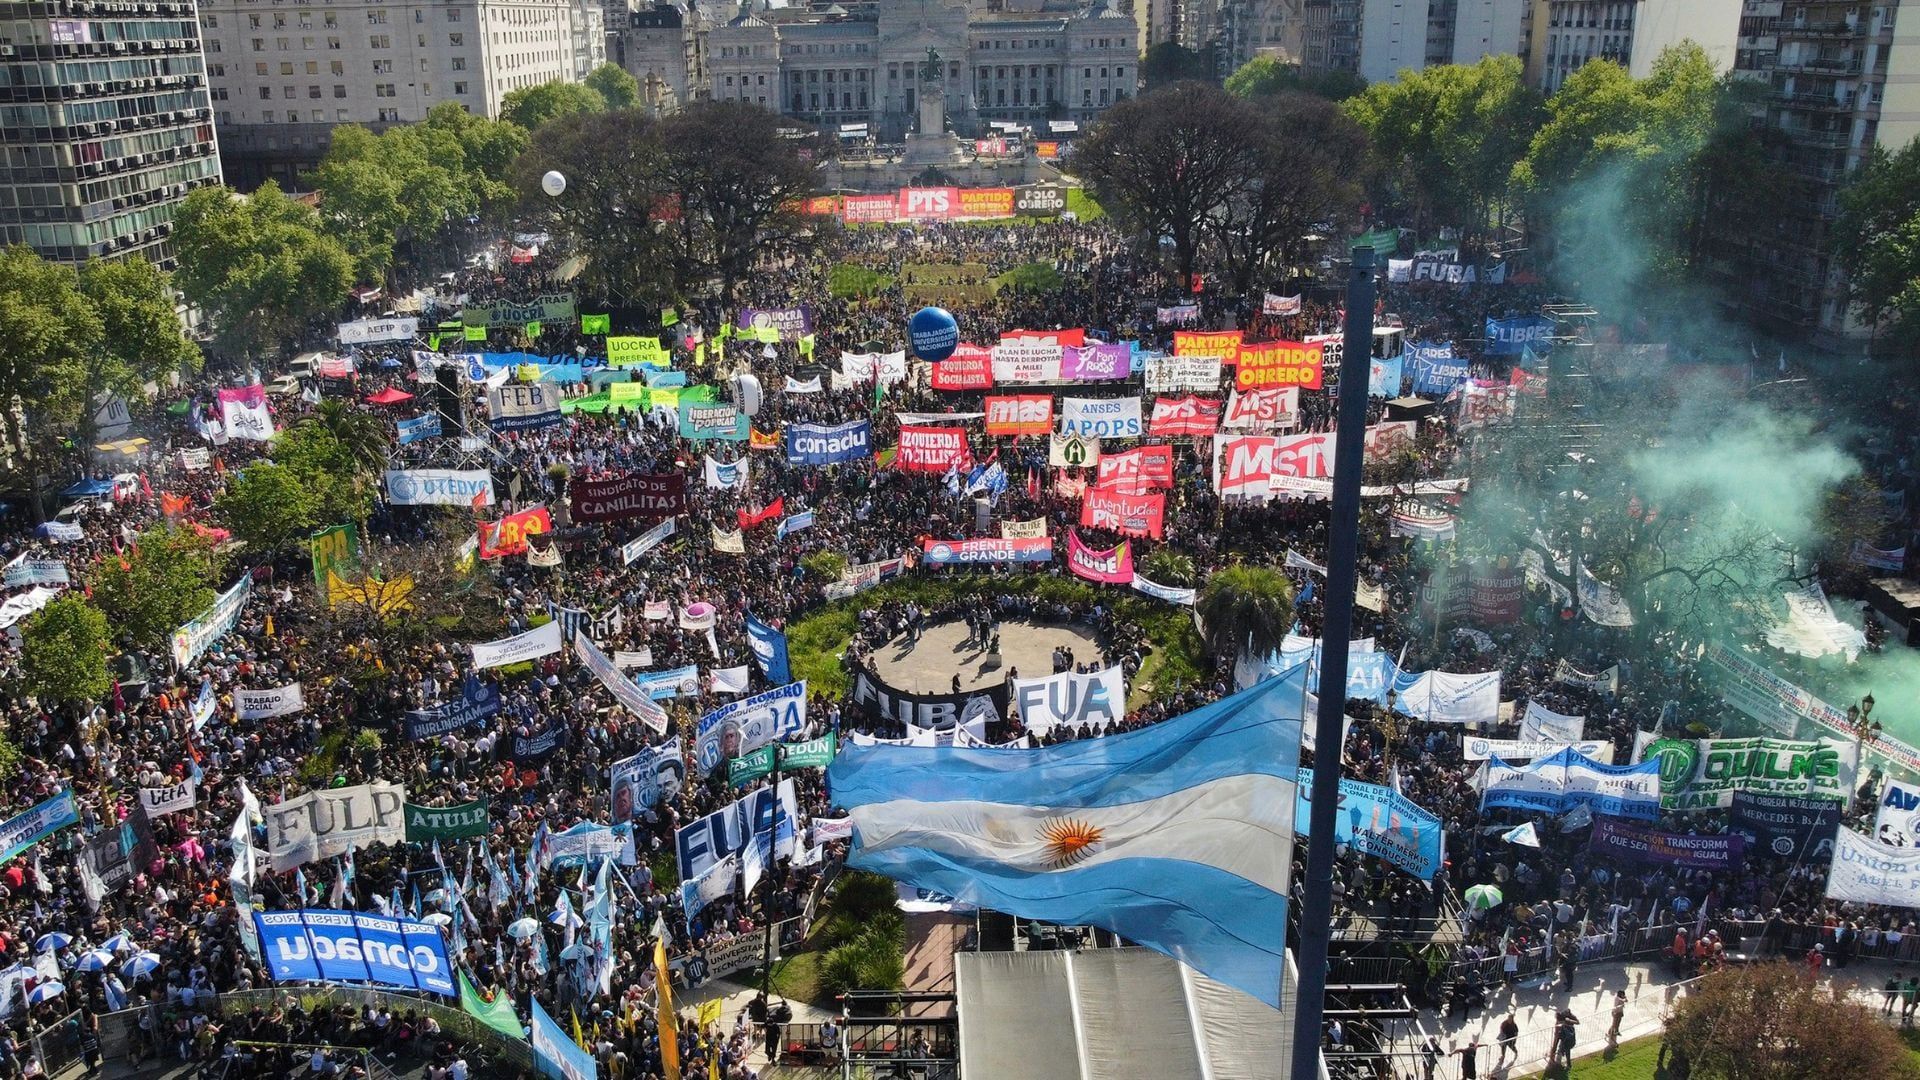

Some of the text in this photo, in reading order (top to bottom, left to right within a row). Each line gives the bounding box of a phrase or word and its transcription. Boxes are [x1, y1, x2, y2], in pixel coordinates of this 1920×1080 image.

[908, 190, 949, 212] PTS
[962, 191, 1011, 202] PARTIDO
[1025, 190, 1056, 200] POLO
[847, 200, 892, 210] IZQUIERDA
[1018, 199, 1063, 210] OBRERO
[1415, 262, 1475, 283] FUBA
[503, 306, 546, 321] UOCRA
[772, 310, 803, 321] UOCRA
[367, 324, 395, 334] AEFIP
[912, 326, 955, 339] TRABAJADORES
[1500, 326, 1554, 343] LIBRES
[612, 340, 656, 351] UOCRA
[918, 341, 955, 351] NACIONALES
[1177, 336, 1239, 348] PARTIDO
[614, 355, 657, 363] PRESENTE
[1240, 349, 1320, 367] PARTIDO
[938, 373, 985, 384] SOCIALISTA
[1015, 371, 1029, 379] PTS
[1239, 368, 1314, 385] OBRERO
[500, 386, 543, 407] FEB
[1241, 390, 1287, 420] MST
[997, 399, 1049, 423] mas
[1081, 403, 1121, 414] ANSES
[1152, 398, 1196, 420] PTS
[1064, 418, 1139, 436] APOPS
[795, 430, 866, 453] conadu
[901, 431, 960, 448] IZQUIERDA
[1100, 454, 1140, 477] PTS
[1228, 444, 1333, 480] MST
[424, 478, 489, 495] UTEDYC
[587, 478, 667, 497] SINDICATO DE
[581, 494, 677, 516] CANILLITAS
[1086, 493, 1146, 516] Juventud
[1093, 510, 1119, 530] PTS
[962, 541, 1013, 551] FRENTE
[960, 551, 1016, 561] GRANDE
[1073, 549, 1118, 573] AUGE
[1363, 654, 1375, 662] de
[243, 695, 281, 704] TRABAJO
[243, 703, 273, 711] SOCIAL
[437, 696, 471, 720] ATSA
[698, 682, 803, 734] SERGIO ROMERO
[1019, 677, 1118, 724] FUA
[413, 706, 482, 738] HURLINGHAM
[1500, 772, 1524, 782] LOM
[1372, 787, 1384, 795] DE
[1344, 789, 1418, 824] LOMAS DE ZAMORA
[1757, 797, 1786, 808] OBRERA
[273, 791, 401, 847] FULP
[411, 806, 485, 828] ATULP
[1741, 808, 1795, 823] MERCEDES
[8, 821, 43, 849] JODE
[1603, 822, 1614, 832] LA
[1667, 837, 1728, 849] TRANSFORMA
[1351, 825, 1429, 866] WALTER MERKIS
[1602, 833, 1608, 841] Y
[1610, 835, 1628, 847] QUE
[1630, 840, 1648, 850] SEA
[1693, 850, 1728, 860] IGUALA
[1358, 838, 1423, 874] CONDUCCION
[709, 933, 762, 954] FEDERACION
